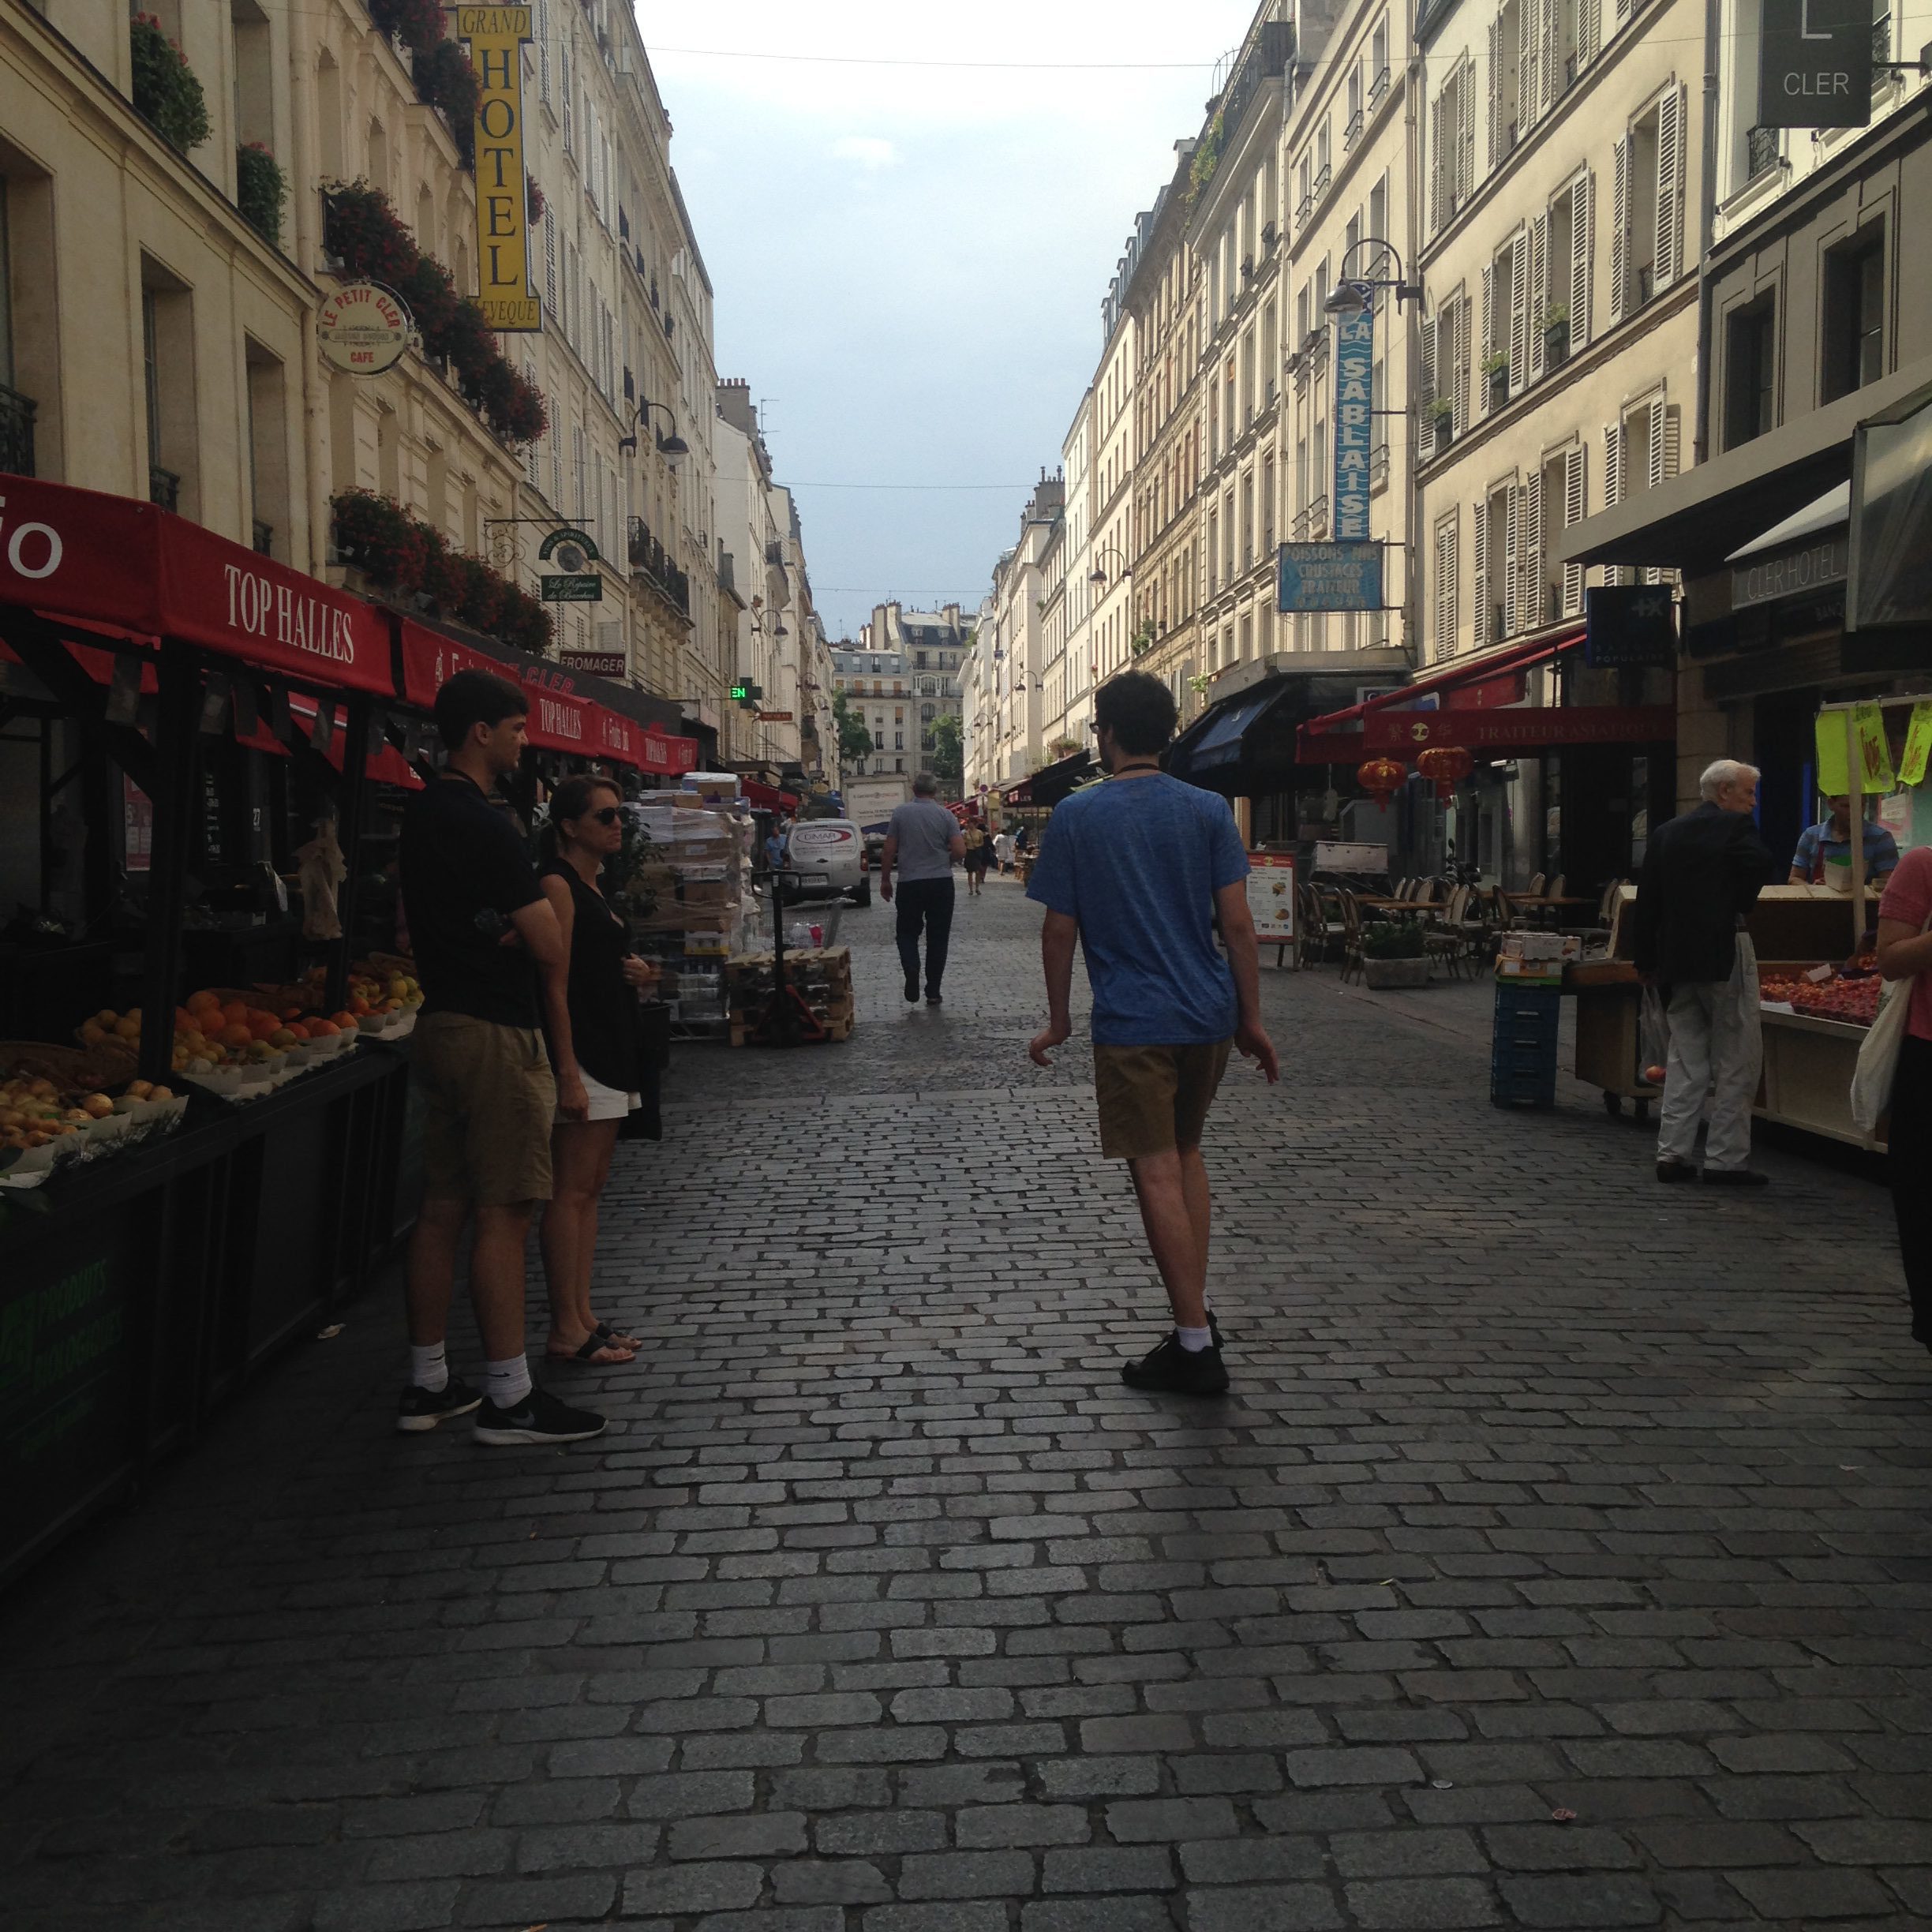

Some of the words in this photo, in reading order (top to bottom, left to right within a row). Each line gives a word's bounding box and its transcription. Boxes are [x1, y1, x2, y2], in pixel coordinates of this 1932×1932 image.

[462, 9, 526, 33] GRAND
[1784, 73, 1849, 95] CLER
[479, 49, 519, 285] HOTEL
[322, 309, 338, 327] LE
[334, 289, 372, 309] PETIT
[375, 296, 401, 328] CLER
[1340, 322, 1372, 339] LA
[350, 352, 375, 363] CAFE
[1340, 358, 1368, 537] SABLAISE
[1747, 560, 1784, 600] CLER
[1788, 544, 1839, 590] HOTEL
[224, 564, 272, 637] TOP
[275, 585, 354, 664] HALLES
[1477, 724, 1567, 740] TRAITEUR
